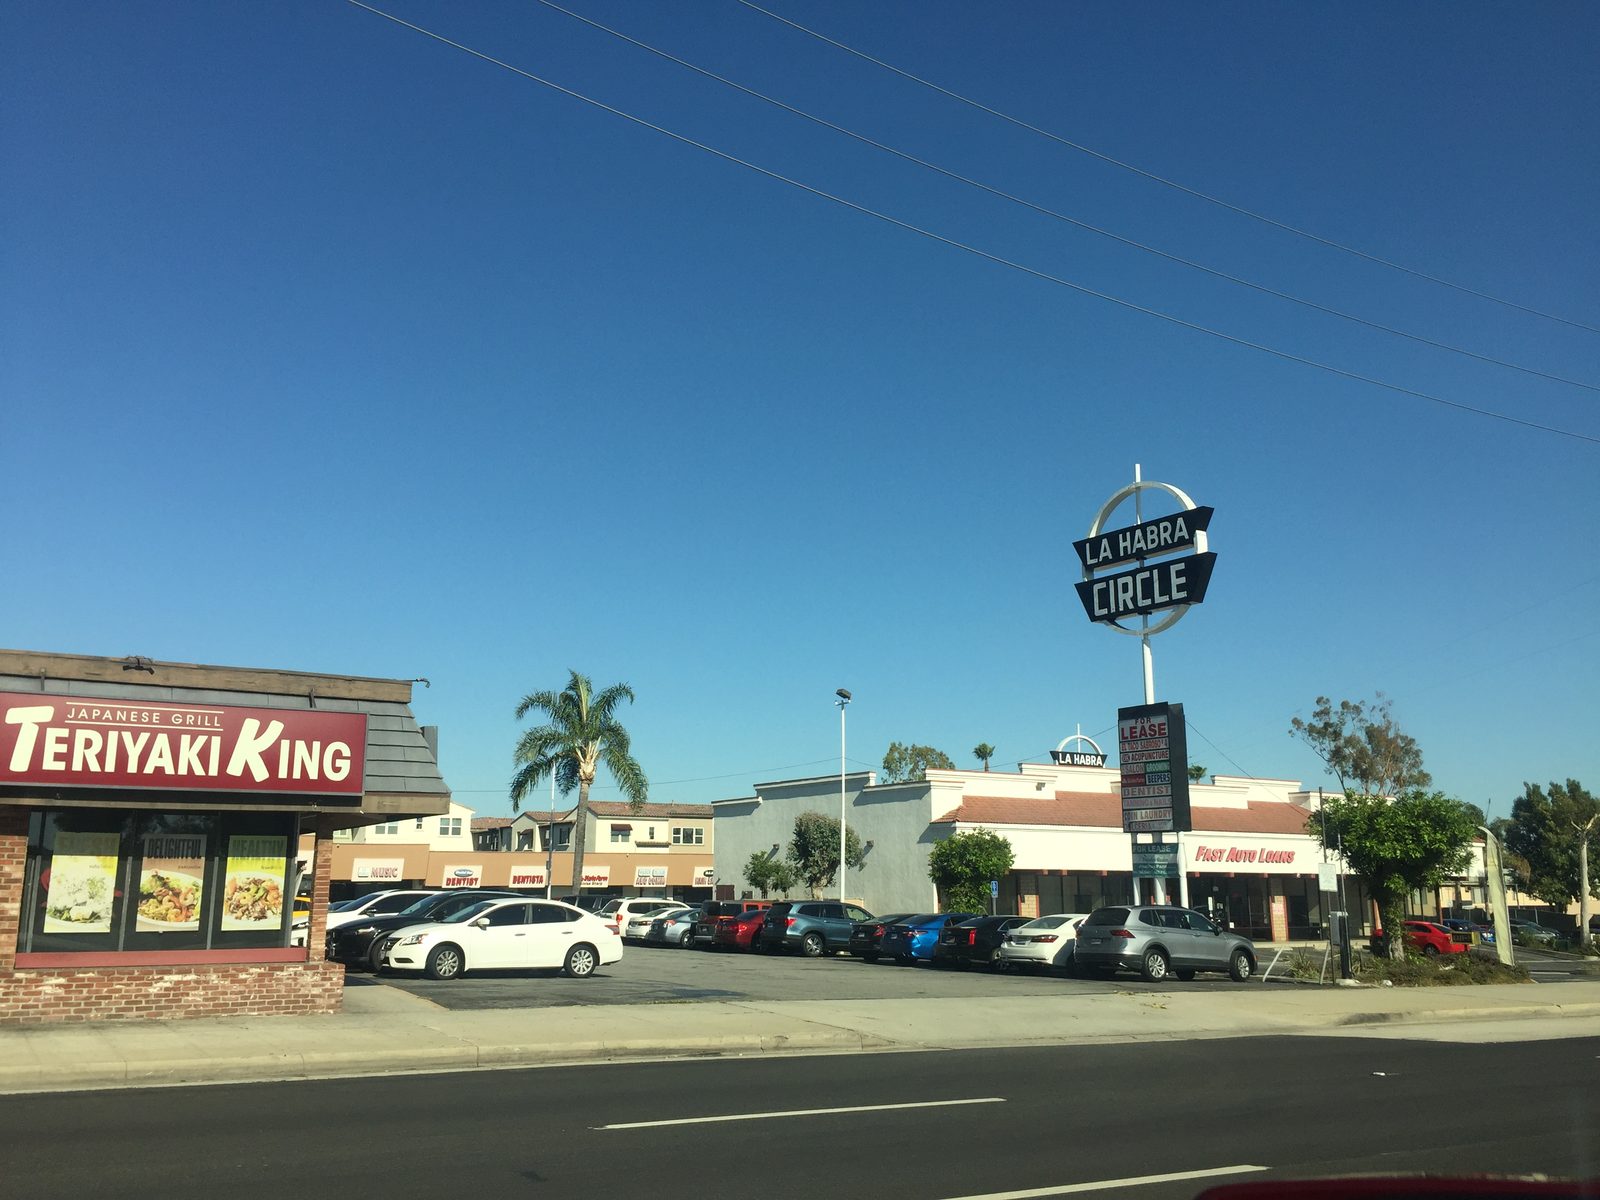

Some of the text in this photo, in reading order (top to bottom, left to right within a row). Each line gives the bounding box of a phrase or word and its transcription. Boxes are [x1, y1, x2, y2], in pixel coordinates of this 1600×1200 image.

[1086, 517, 1189, 565] LA HABRA
[1093, 563, 1187, 616] CIRCLE
[67, 706, 221, 727] JAPANESE GRILL
[1135, 717, 1151, 725] FOR
[1121, 722, 1166, 740] LEASE
[5, 705, 351, 783] TERIYAKI KING
[1059, 753, 1103, 766] LA HABRA
[1131, 750, 1169, 761] ACUPUNCTURE
[1147, 773, 1170, 784] BEEPERS
[1123, 786, 1170, 796] DENTIST
[1140, 809, 1171, 819] LAUNDRY
[147, 838, 202, 859] DELIGHTFUL
[1133, 844, 1171, 853] FOR LEASE
[1195, 846, 1295, 864] FAST AUTO LOANS
[371, 867, 398, 878] MUSIC
[445, 877, 479, 886] DENTIST
[512, 875, 544, 884] DENTISTA
